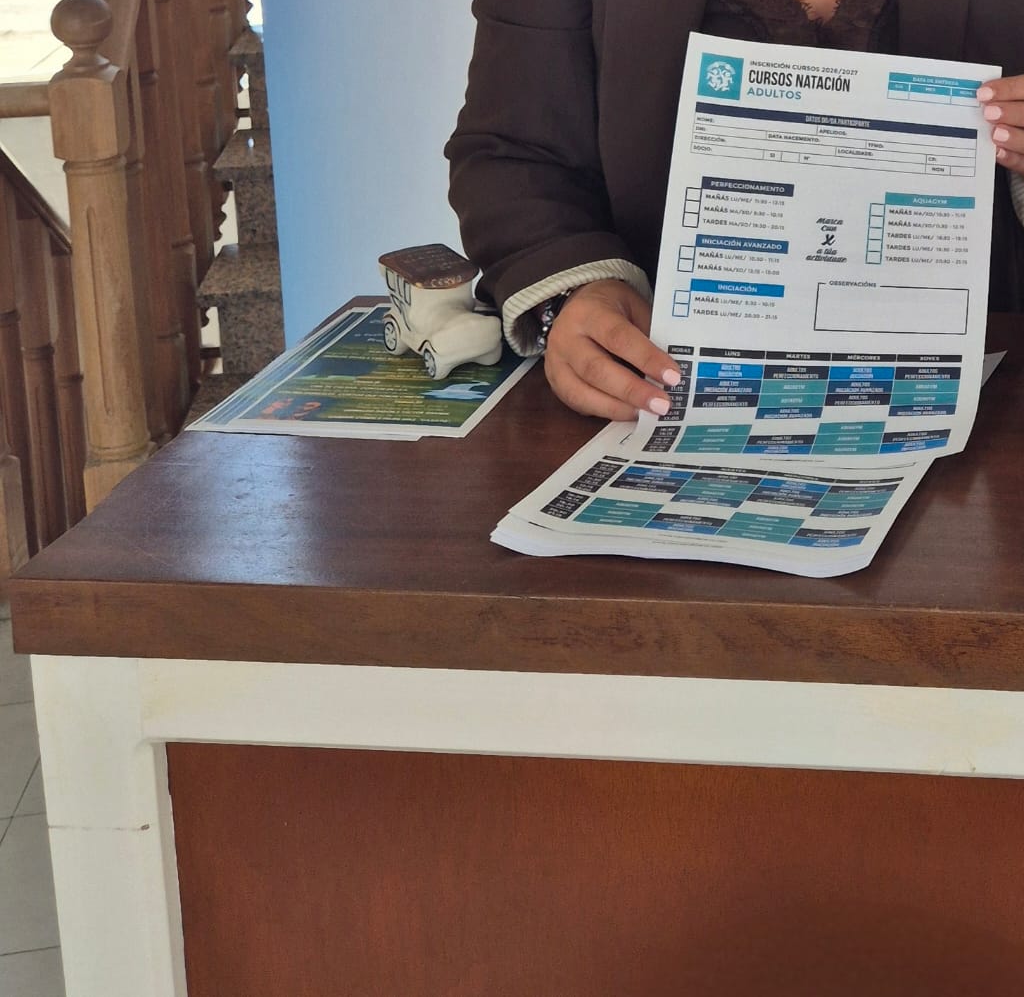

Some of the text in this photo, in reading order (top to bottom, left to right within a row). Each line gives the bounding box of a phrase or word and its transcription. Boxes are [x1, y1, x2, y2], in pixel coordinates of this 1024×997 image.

[750, 60, 790, 69] INSCRICIÓN
[792, 64, 819, 72] CURSOS
[749, 70, 850, 92] CURSOS NATACIÓN
[747, 88, 801, 100] ADULTOS
[711, 181, 785, 193] PERFECCIONAMENTO
[702, 238, 782, 250] INICIACIÓN AVANZADO
[699, 251, 723, 259] MAÑÁS
[718, 284, 757, 292] INICIACIÓN
[695, 295, 719, 303] MAÑÁS
